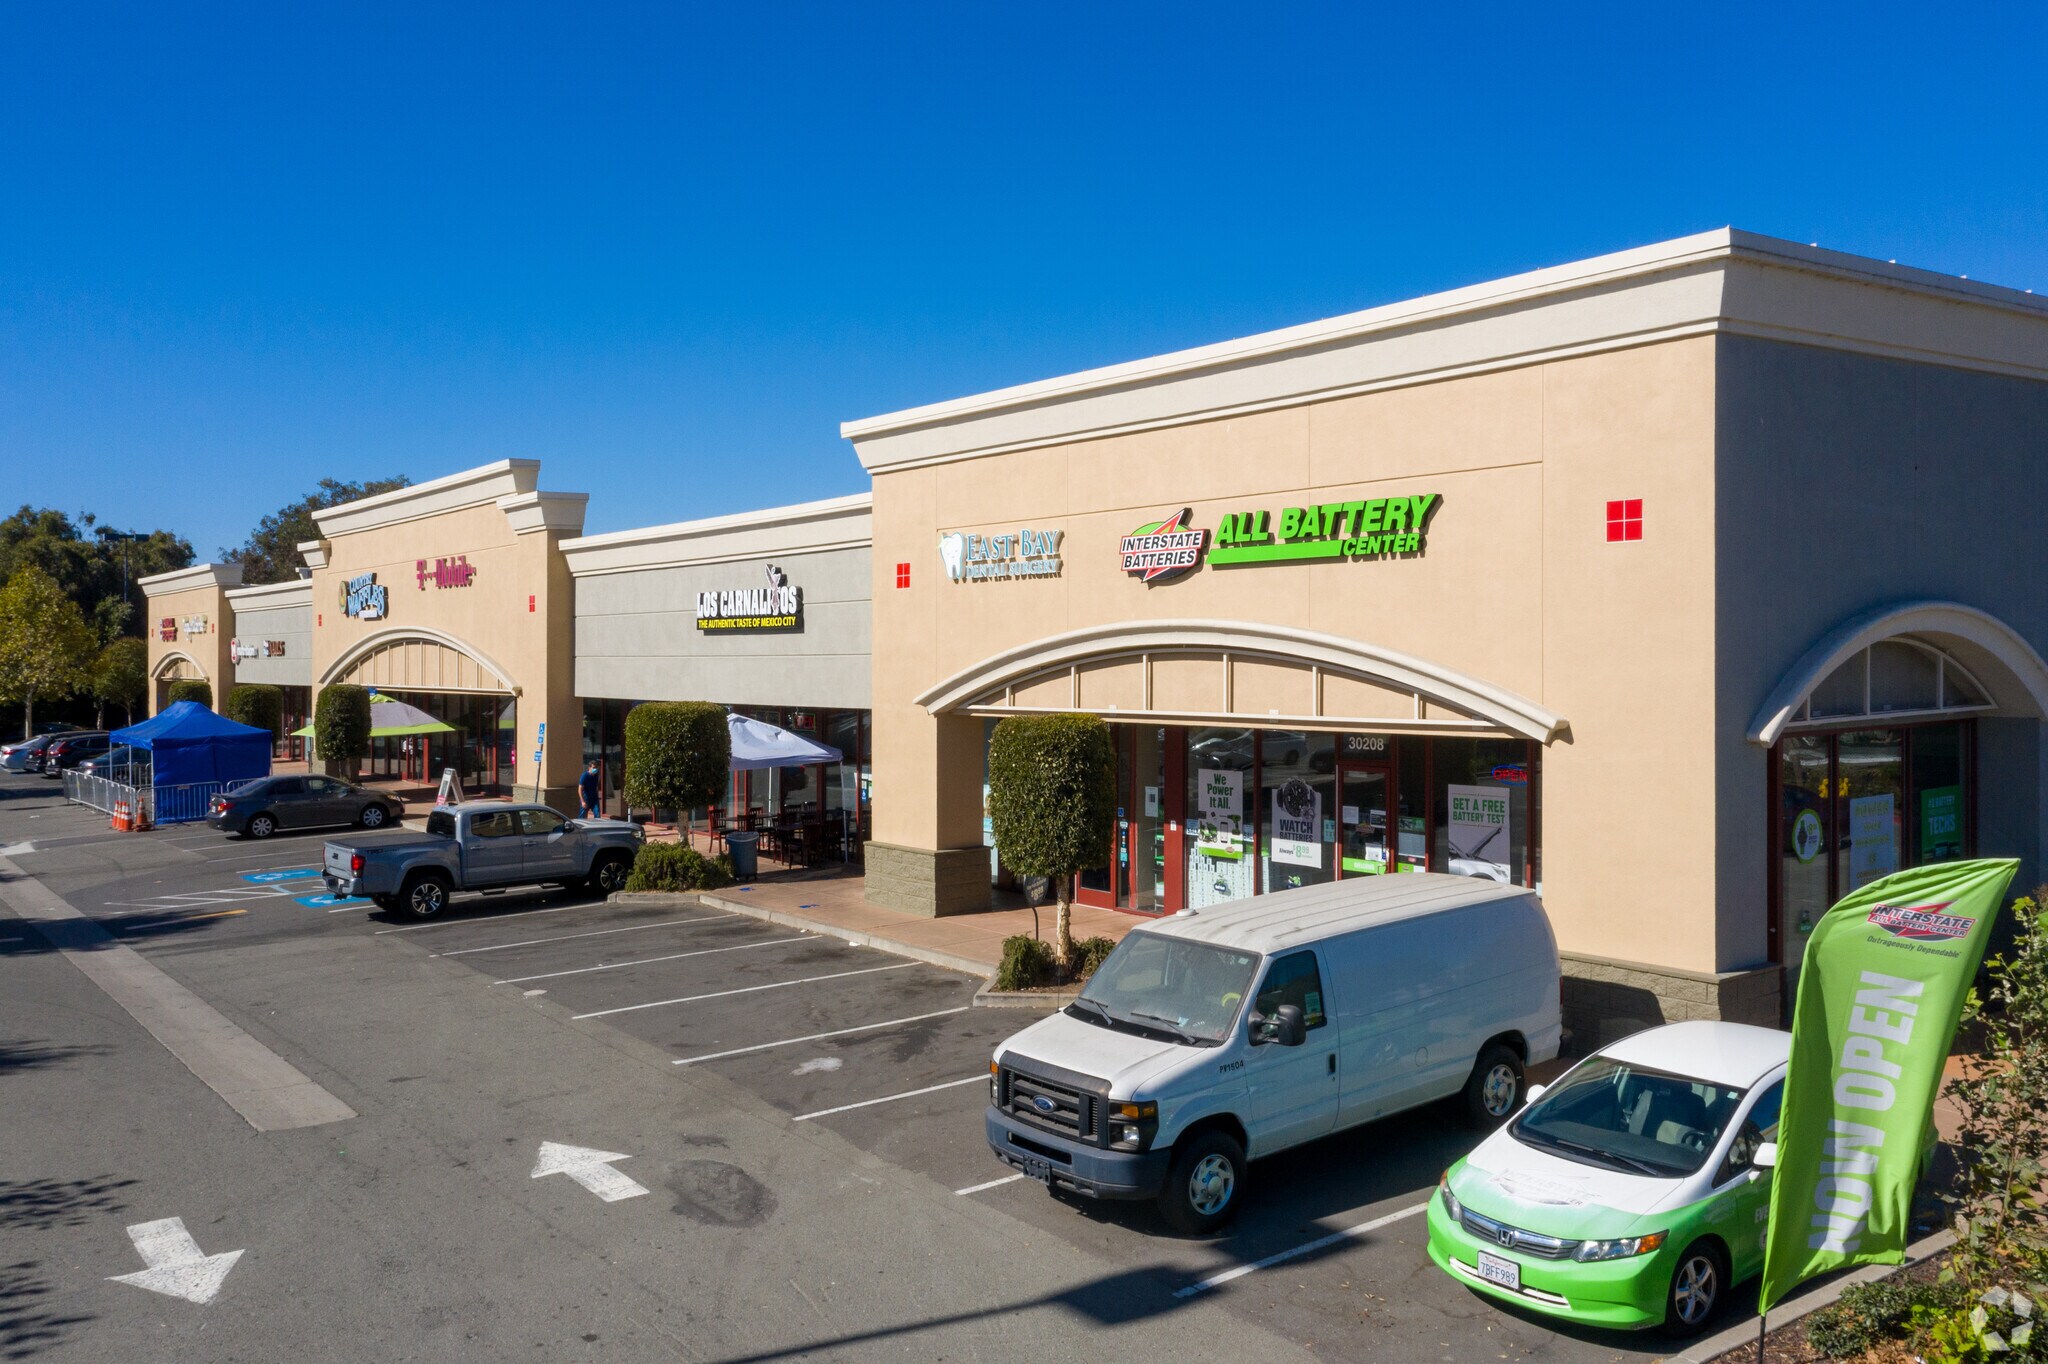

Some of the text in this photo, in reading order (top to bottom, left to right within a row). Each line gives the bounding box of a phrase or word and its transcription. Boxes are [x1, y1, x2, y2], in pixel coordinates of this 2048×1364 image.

[1213, 493, 1437, 544] ALL BATTERY
[967, 529, 1058, 561] EAST BAY
[1122, 532, 1201, 552] INTERSTATE
[1342, 532, 1420, 556] CENTER
[1124, 550, 1196, 568] BATTERIES
[966, 559, 1059, 579] DENTAL SURGERY
[697, 591, 718, 618] LOS
[698, 616, 796, 629] THE AUTHENTIC TASTE OF MEXICO CITY
[1349, 736, 1384, 750] 30208
[1213, 773, 1227, 785] We
[1493, 769, 1528, 782] OPEN
[1207, 783, 1234, 796] Power
[1209, 797, 1231, 810] It All.
[1453, 797, 1506, 813] GET A FREE
[1279, 819, 1313, 834] WATCH
[1453, 811, 1505, 824] BATTERY TEST
[1279, 832, 1313, 843] BATTERIES
[1871, 915, 1966, 937] ALL BATTERY CENTER
[1874, 906, 1972, 929] INTERSTATE
[1867, 935, 1962, 958] Outrageously Dependable
[1807, 970, 1925, 1254] NOW OPEN
[1481, 1262, 1516, 1284] 7BFF989
